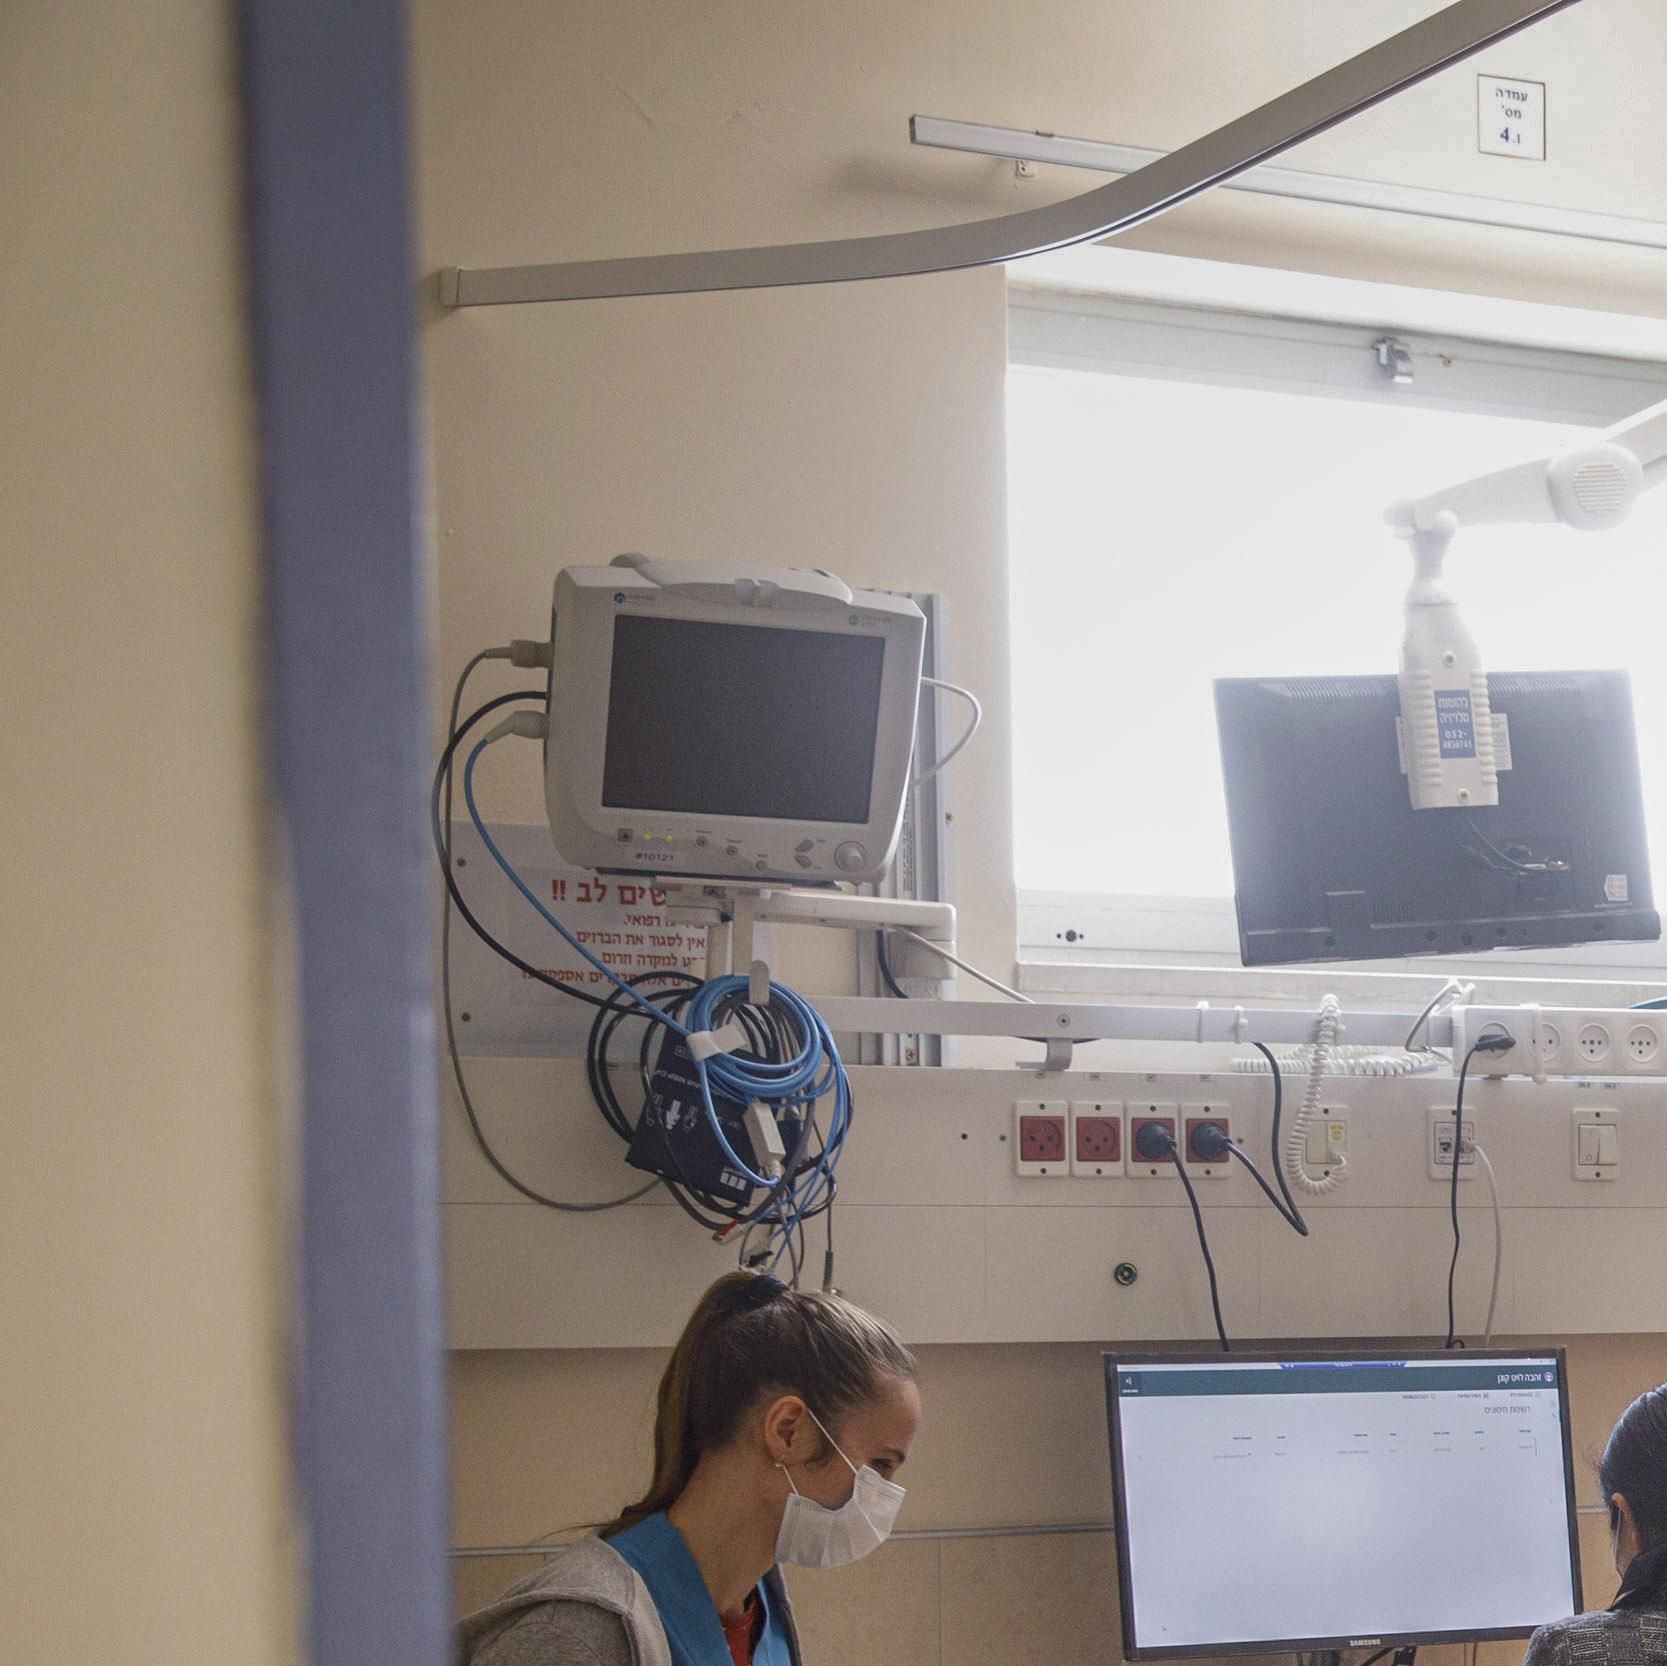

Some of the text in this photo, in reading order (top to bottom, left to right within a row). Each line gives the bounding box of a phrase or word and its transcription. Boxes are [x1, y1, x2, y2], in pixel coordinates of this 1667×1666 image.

[1496, 87, 1528, 102] עמדה
[552, 877, 666, 907] שים לב !!
[577, 930, 705, 951] אין לסגור את הברזים
[637, 953, 677, 969] למקרה
